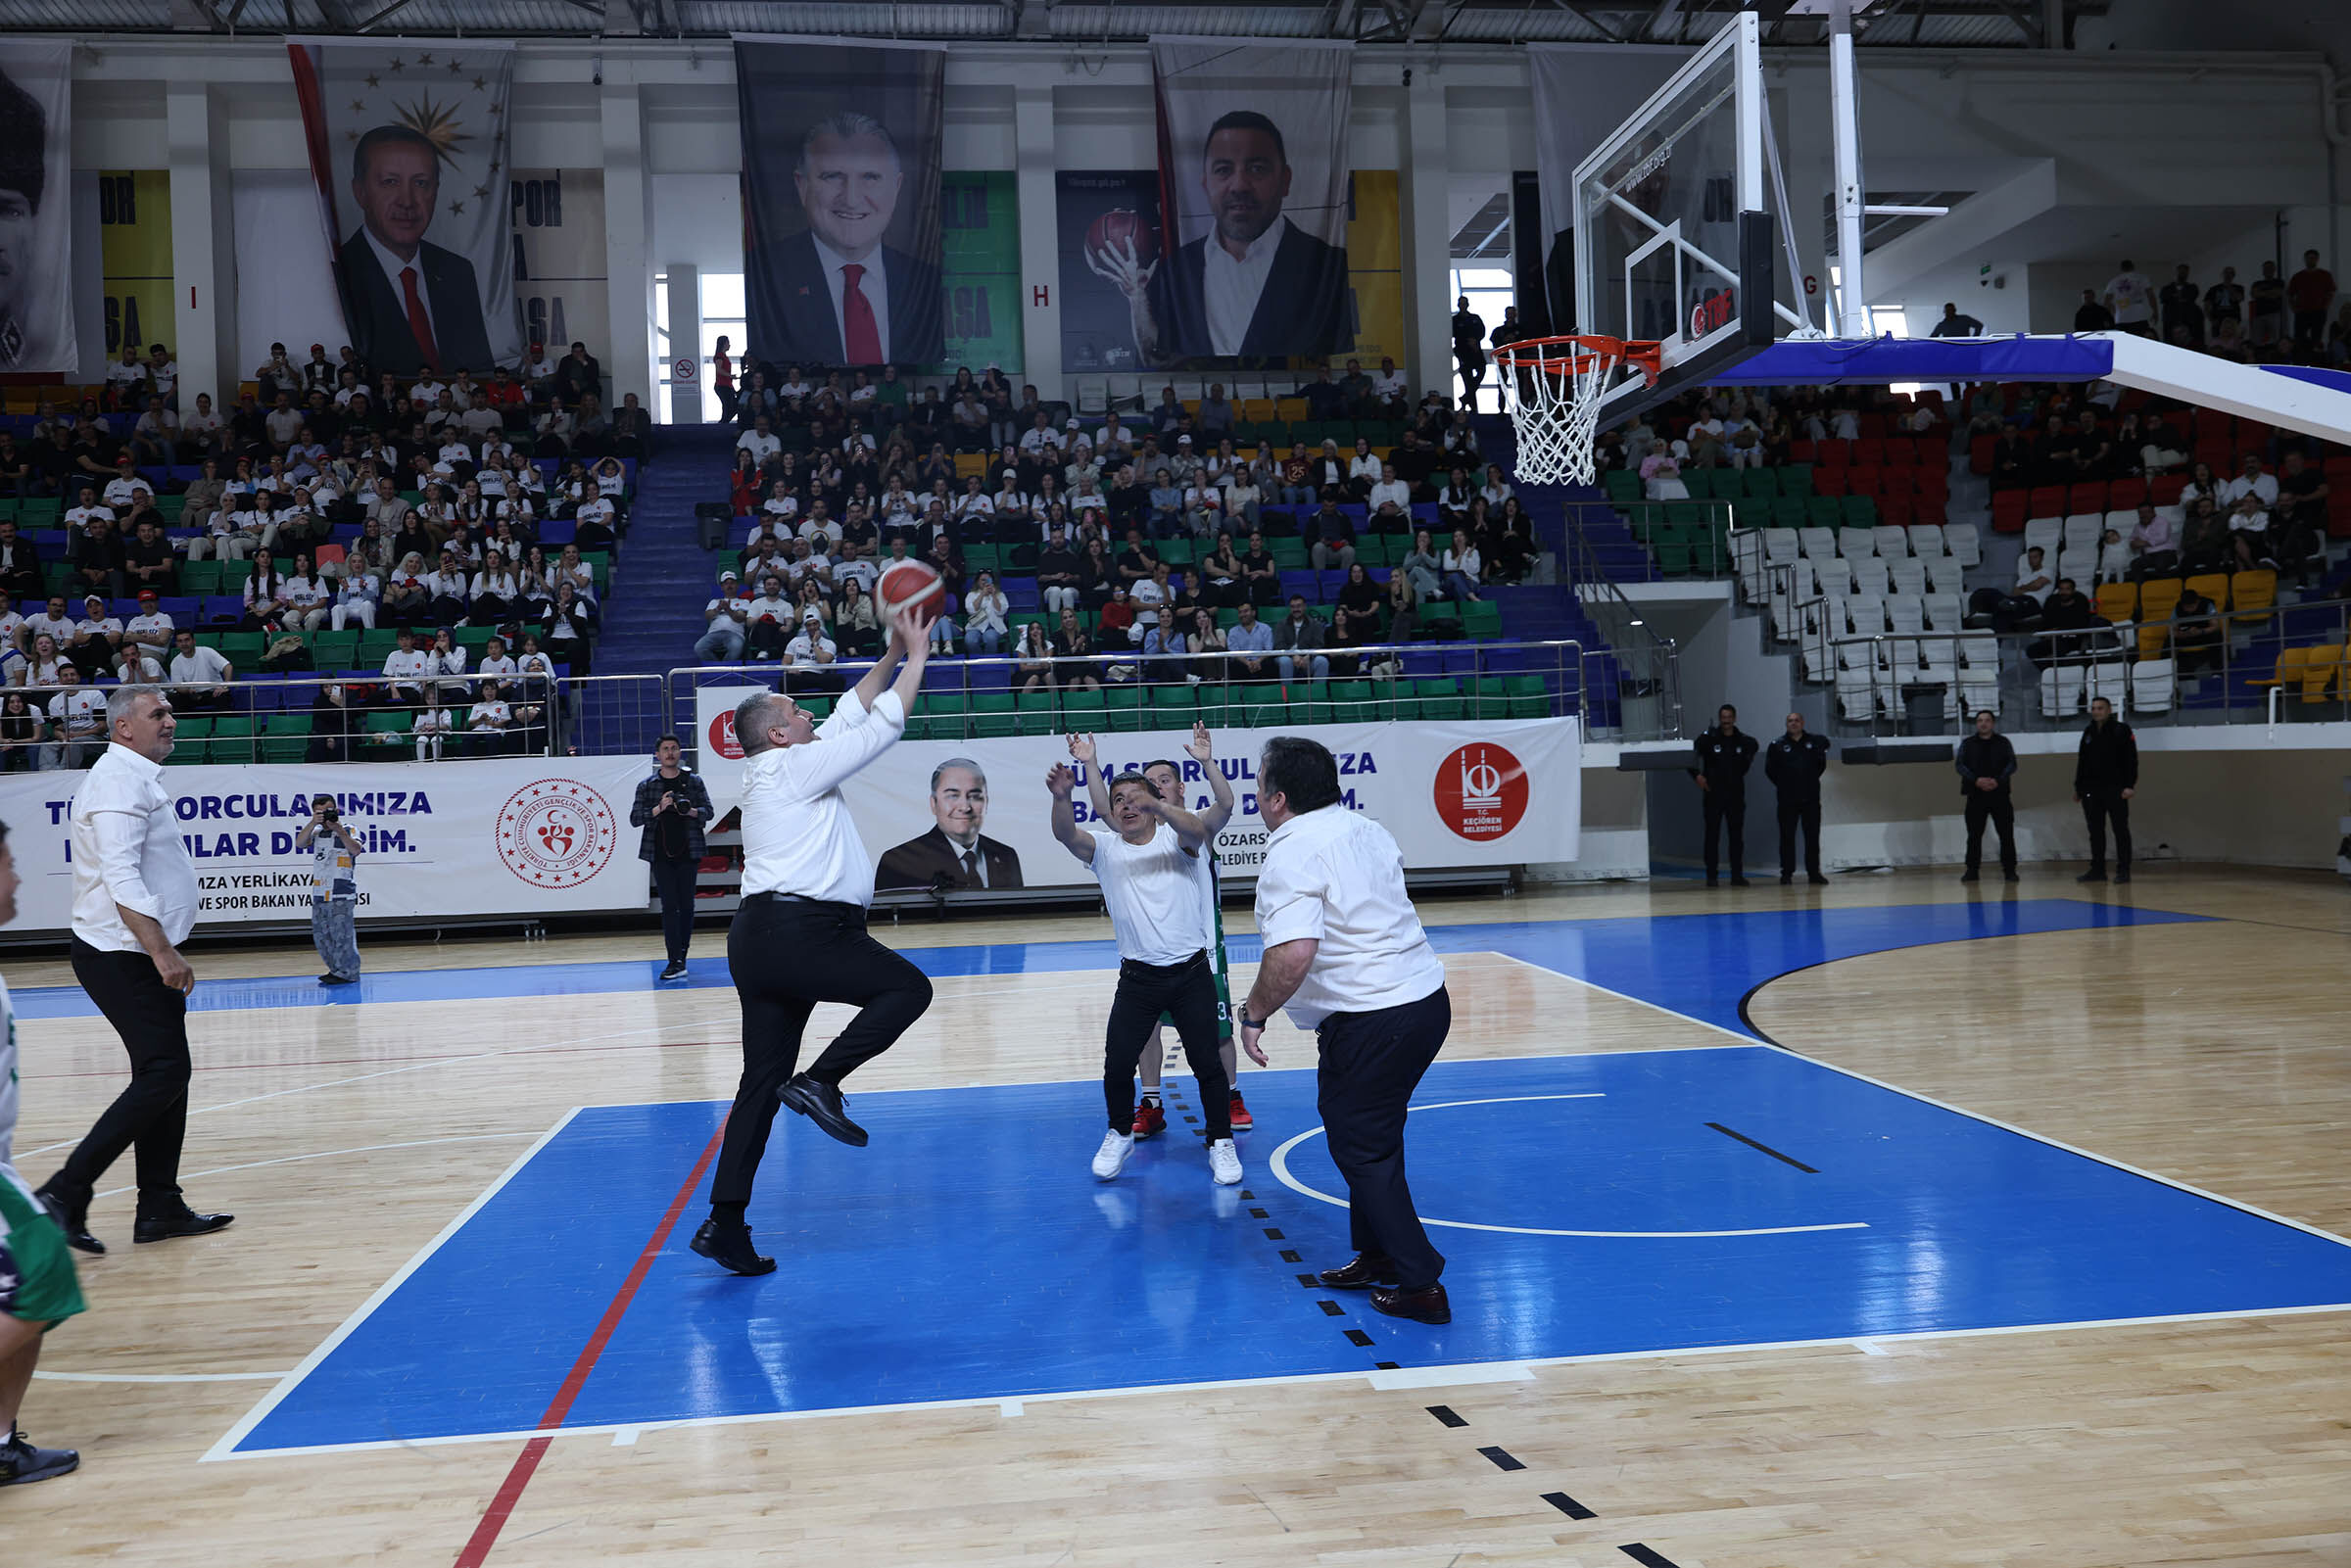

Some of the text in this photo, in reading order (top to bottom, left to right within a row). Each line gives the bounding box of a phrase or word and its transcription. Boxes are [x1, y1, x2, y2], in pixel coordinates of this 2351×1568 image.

[510, 179, 562, 226] POR
[1803, 275, 1817, 294] G
[1032, 285, 1049, 308] H
[174, 791, 433, 821] ORCULAIMIZA
[231, 872, 313, 888] YERLİKAY
[216, 896, 248, 910] SPOR
[252, 894, 295, 909] BAKAN
